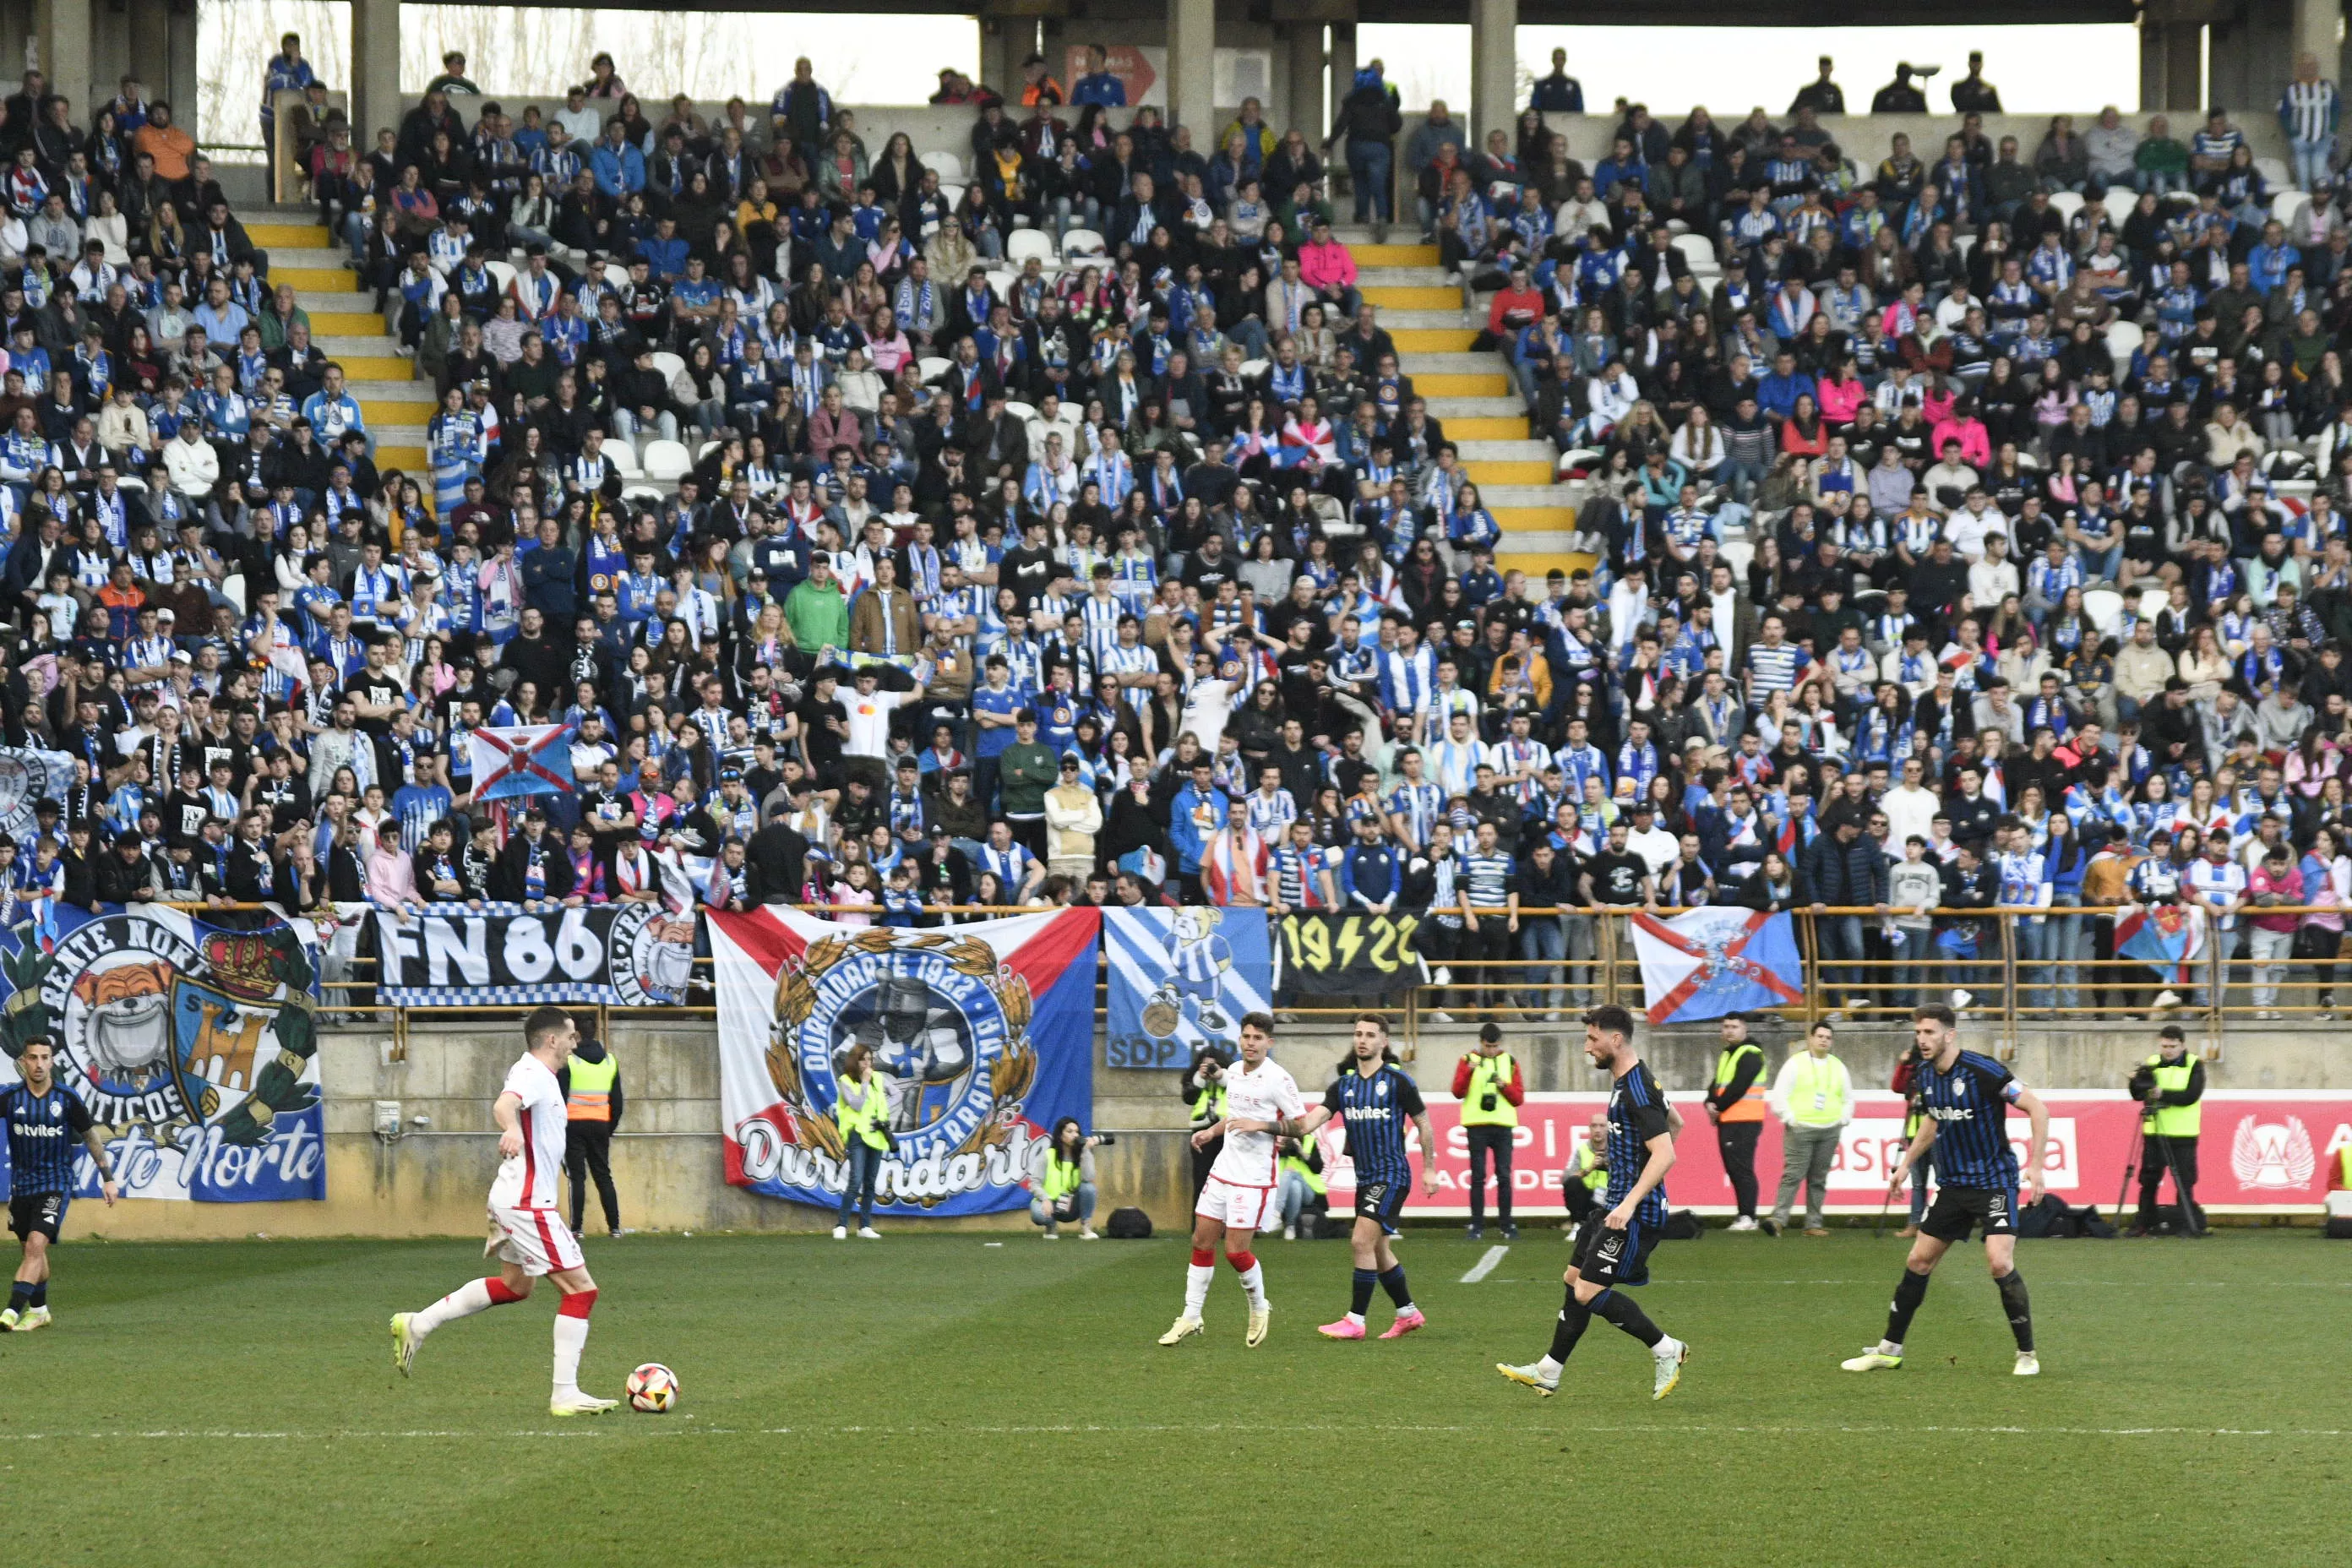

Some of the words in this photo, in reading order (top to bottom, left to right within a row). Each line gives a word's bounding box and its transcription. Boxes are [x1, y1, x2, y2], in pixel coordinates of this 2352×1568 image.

[127, 919, 215, 977] NORT
[375, 912, 490, 986] FN
[503, 907, 603, 983] 86
[1282, 915, 1332, 972] 19
[1369, 915, 1420, 973] 22
[917, 954, 977, 1003] 1922
[1108, 1038, 1177, 1066] SDP
[24, 1124, 64, 1138] tvitec
[1353, 1106, 1391, 1120] tvitec
[175, 1118, 324, 1191] Norte
[737, 1122, 1052, 1200] Durndarte
[1435, 1169, 1565, 1190] ACADE
